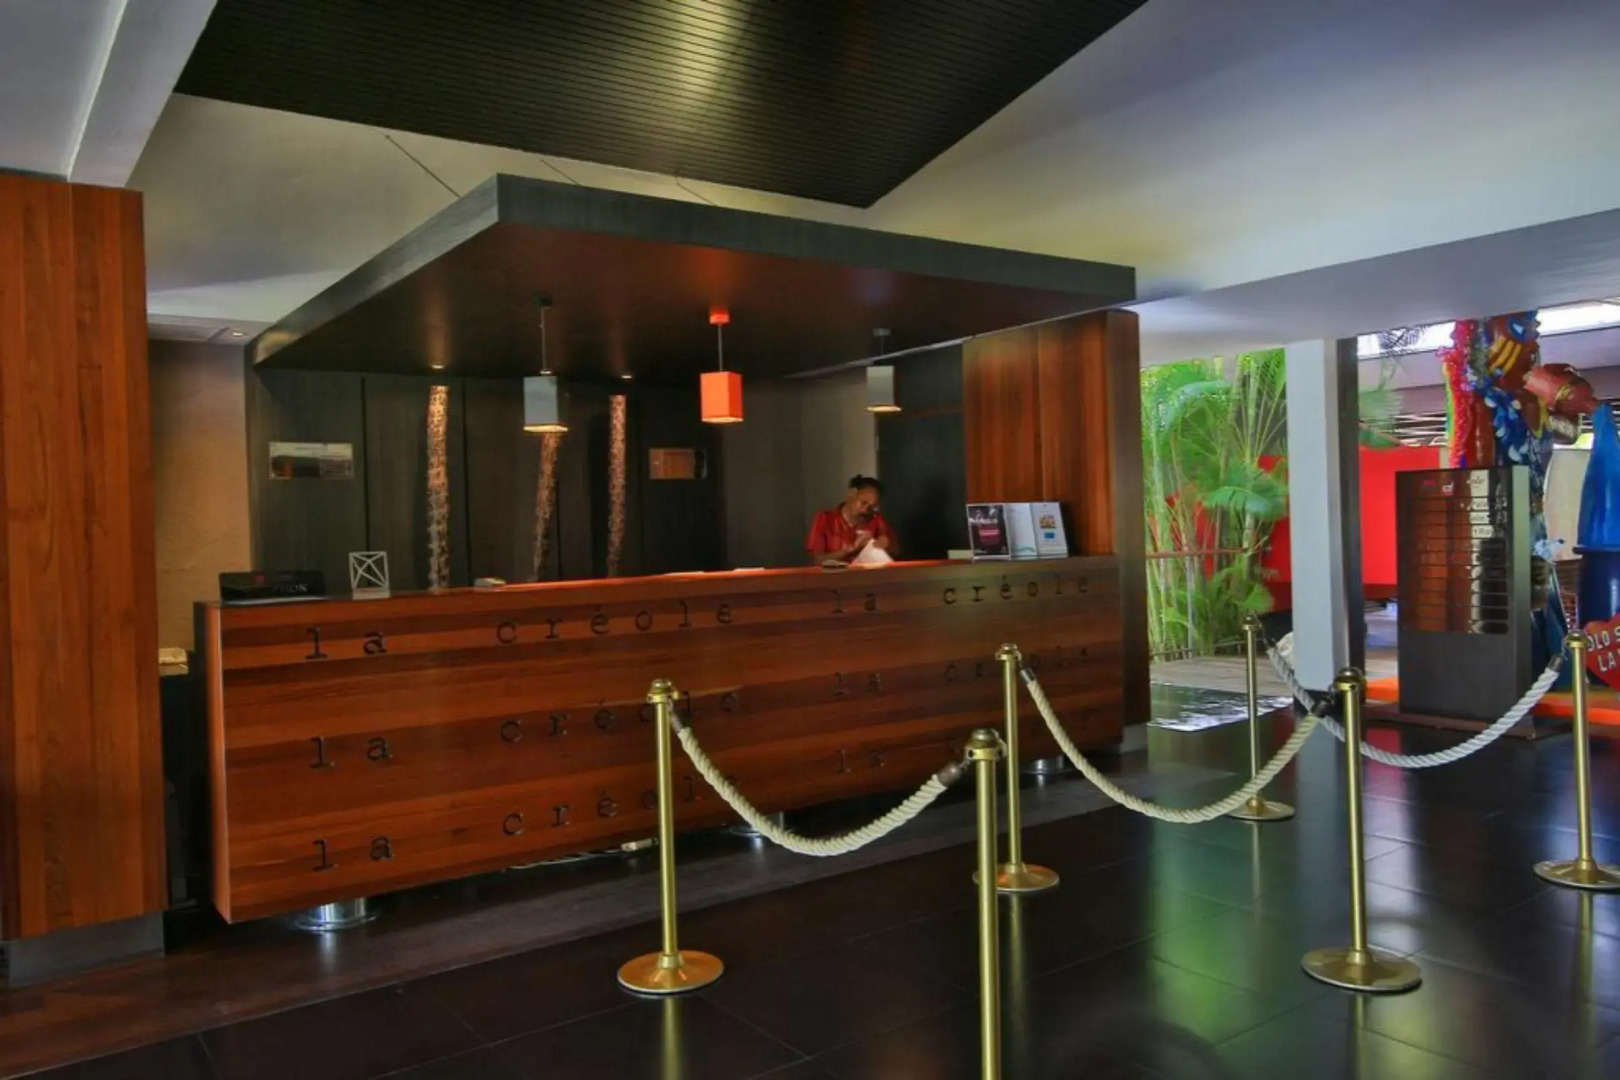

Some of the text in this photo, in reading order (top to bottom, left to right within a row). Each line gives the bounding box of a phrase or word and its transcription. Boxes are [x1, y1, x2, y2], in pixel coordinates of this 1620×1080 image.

[830, 588, 877, 614] la
[305, 627, 388, 660] la
[309, 735, 393, 768] la
[311, 775, 739, 872] la créol
